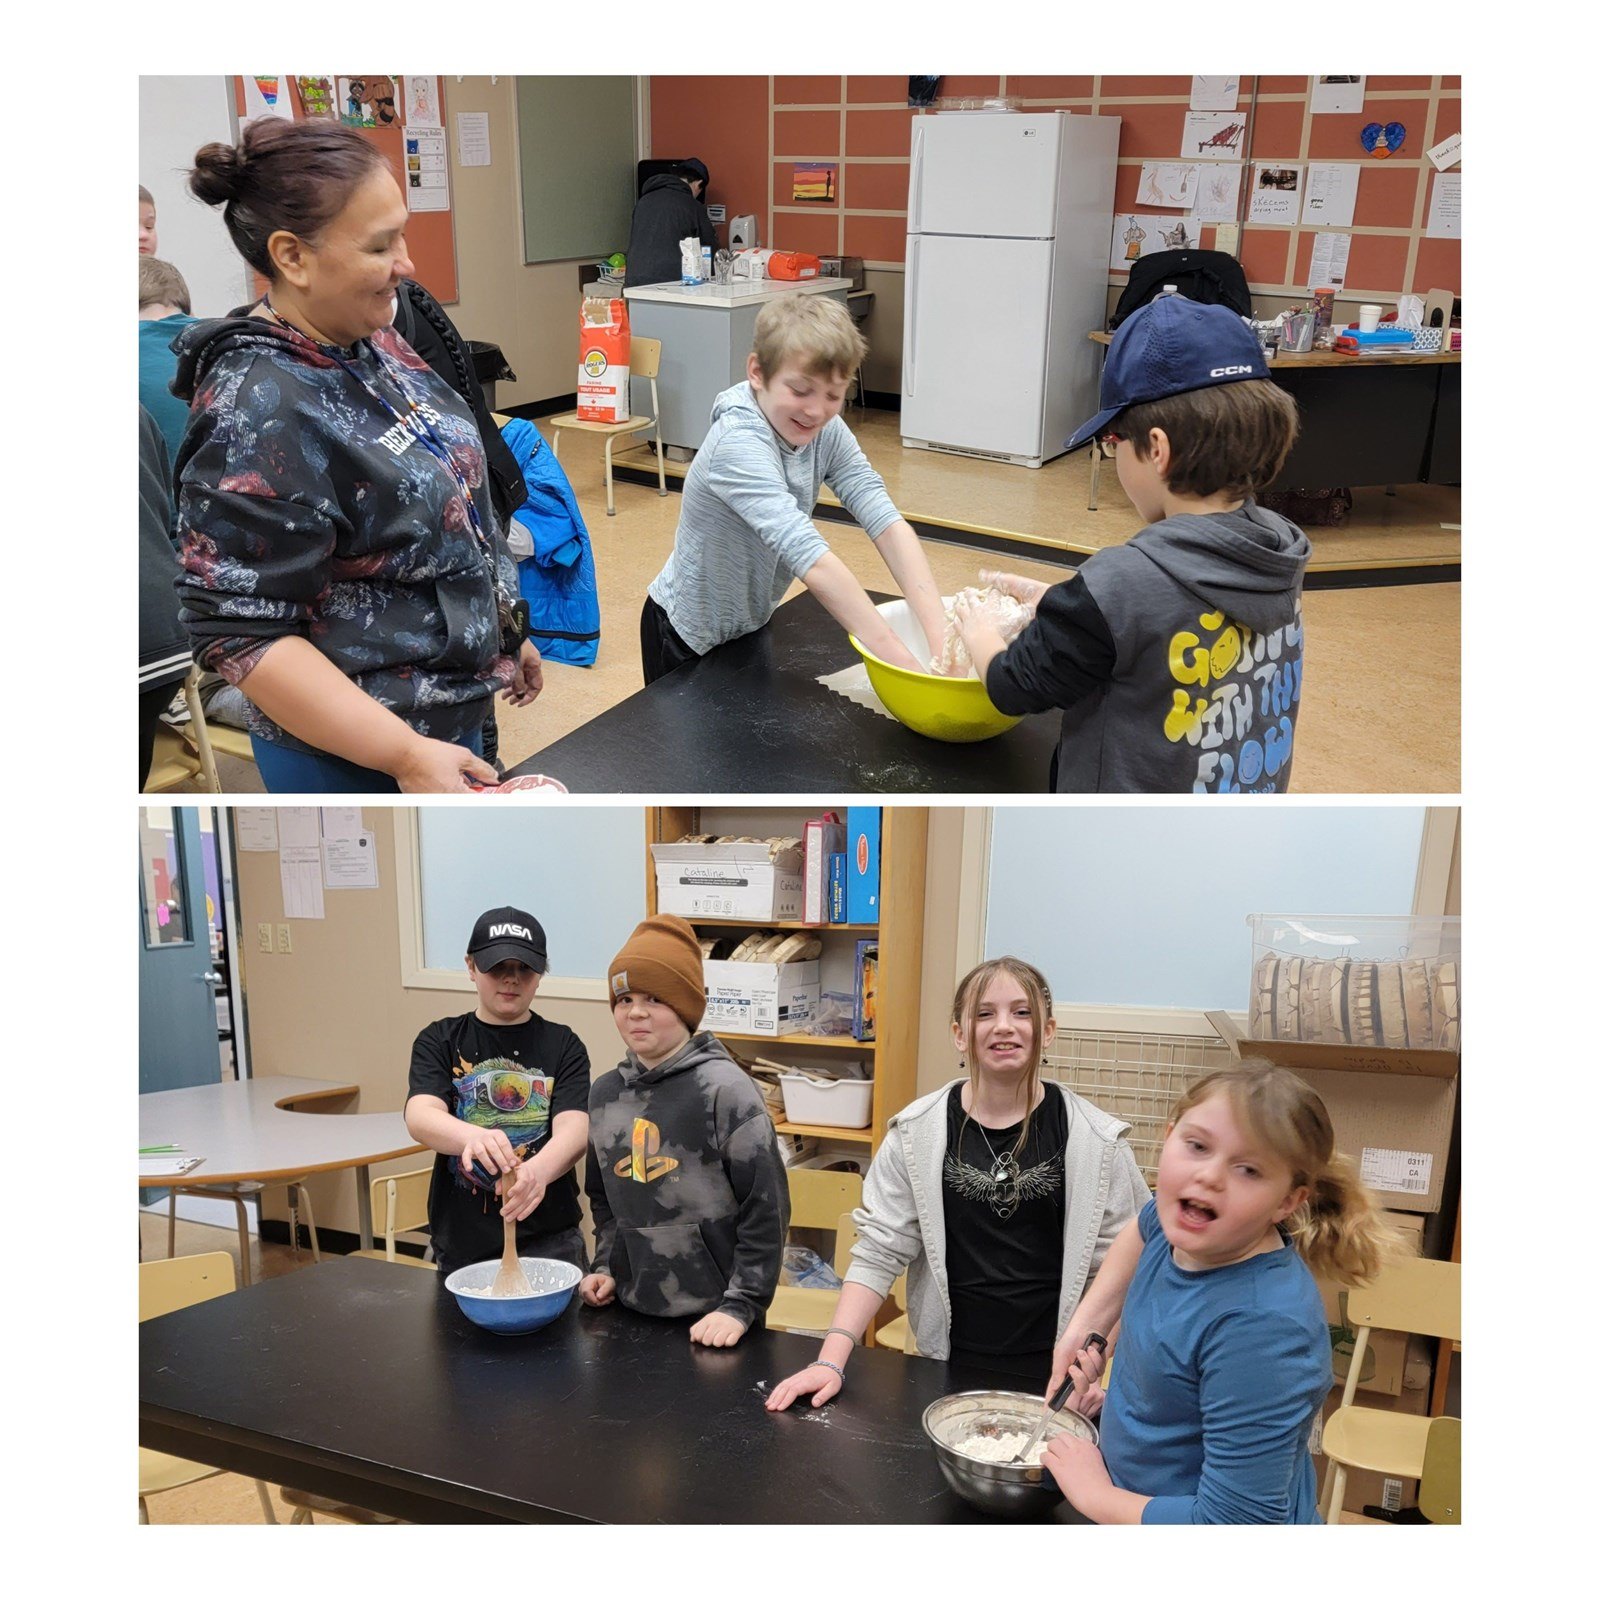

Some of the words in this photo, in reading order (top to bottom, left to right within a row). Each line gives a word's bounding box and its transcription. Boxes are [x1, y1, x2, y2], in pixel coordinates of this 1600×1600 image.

[1210, 365, 1252, 378] CCM
[1164, 683, 1254, 749] WITH
[684, 867, 725, 877] Cataline
[489, 924, 533, 940] NASA
[1407, 1158, 1425, 1166] 0311
[1409, 1169, 1419, 1177] CA
